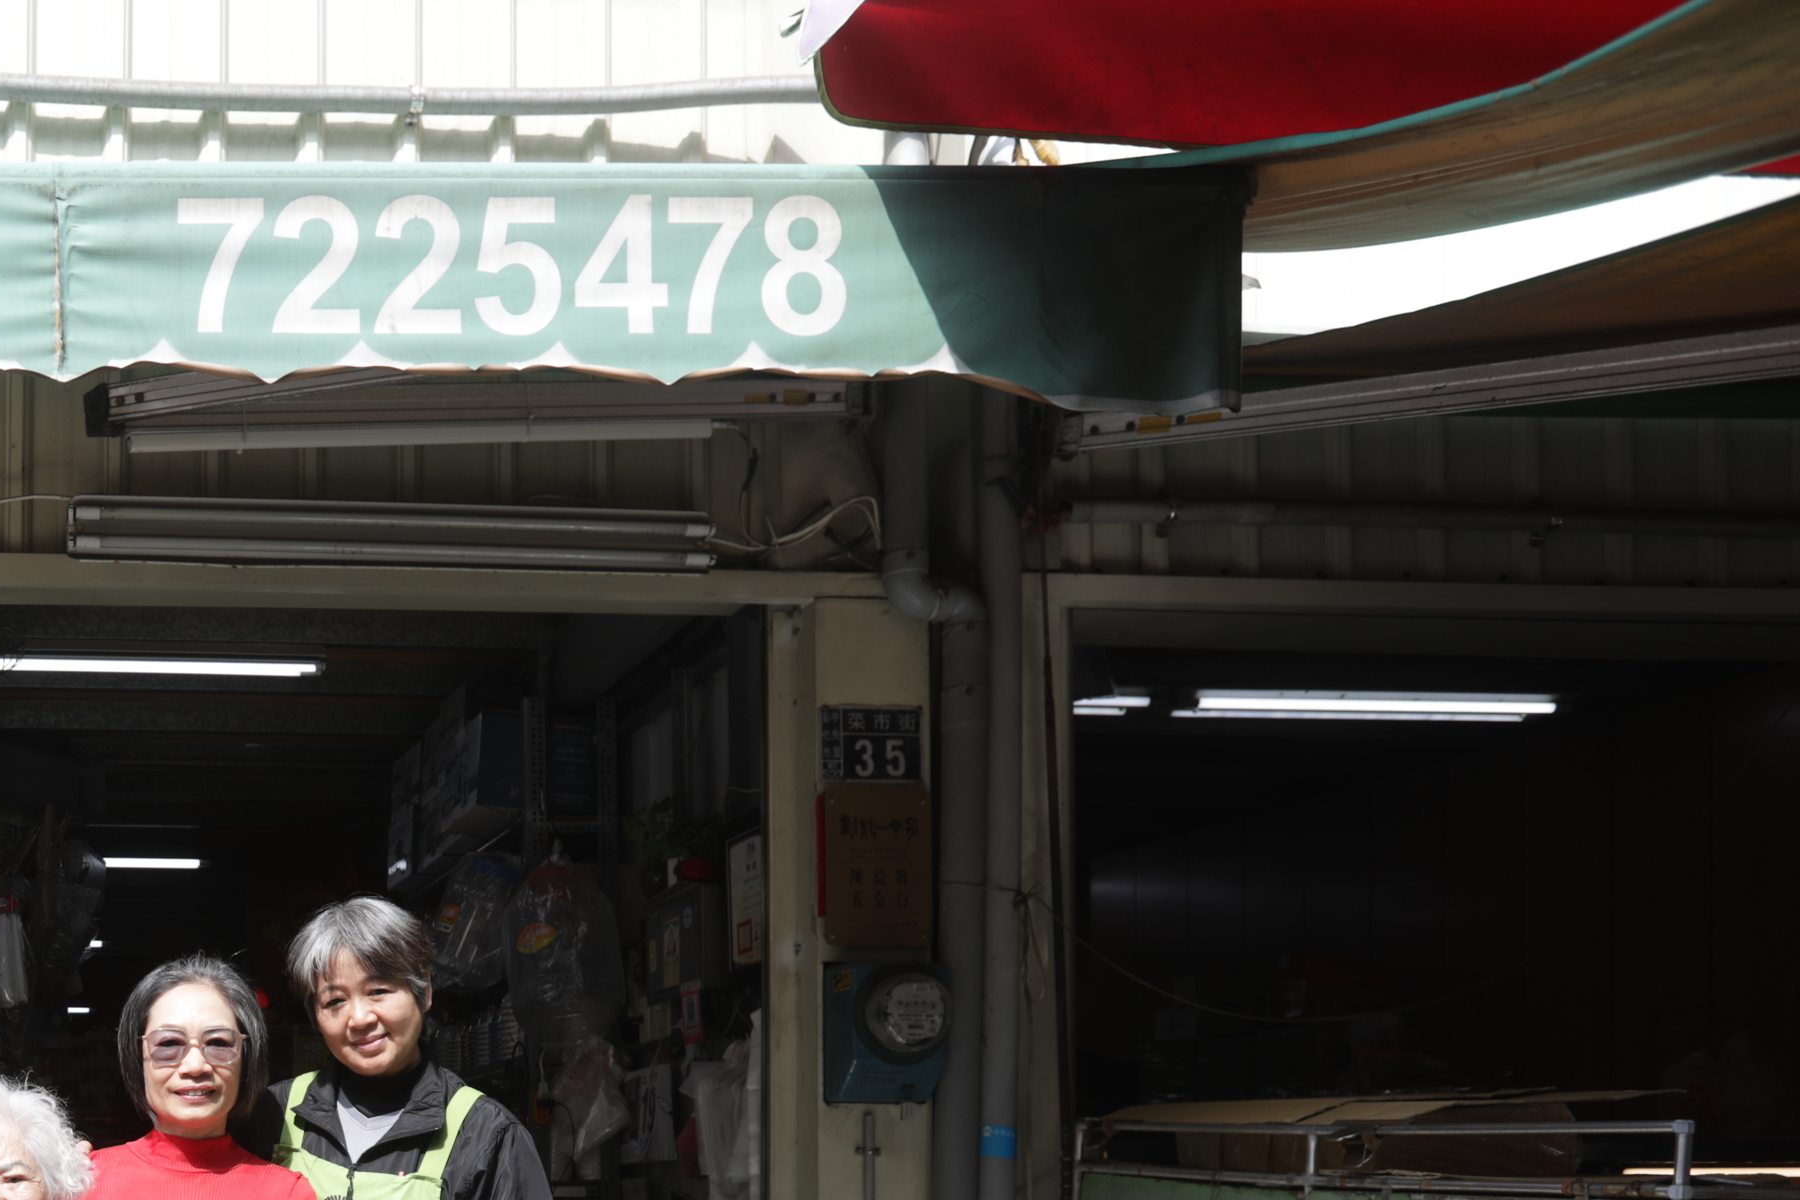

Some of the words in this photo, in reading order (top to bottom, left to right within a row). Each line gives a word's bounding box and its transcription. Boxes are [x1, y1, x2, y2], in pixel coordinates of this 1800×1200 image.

[177, 193, 848, 337] 7225478
[847, 711, 917, 732] 菜市街
[854, 738, 907, 778] 35
[849, 867, 909, 886] 陳益發
[850, 890, 909, 909] 五金行
